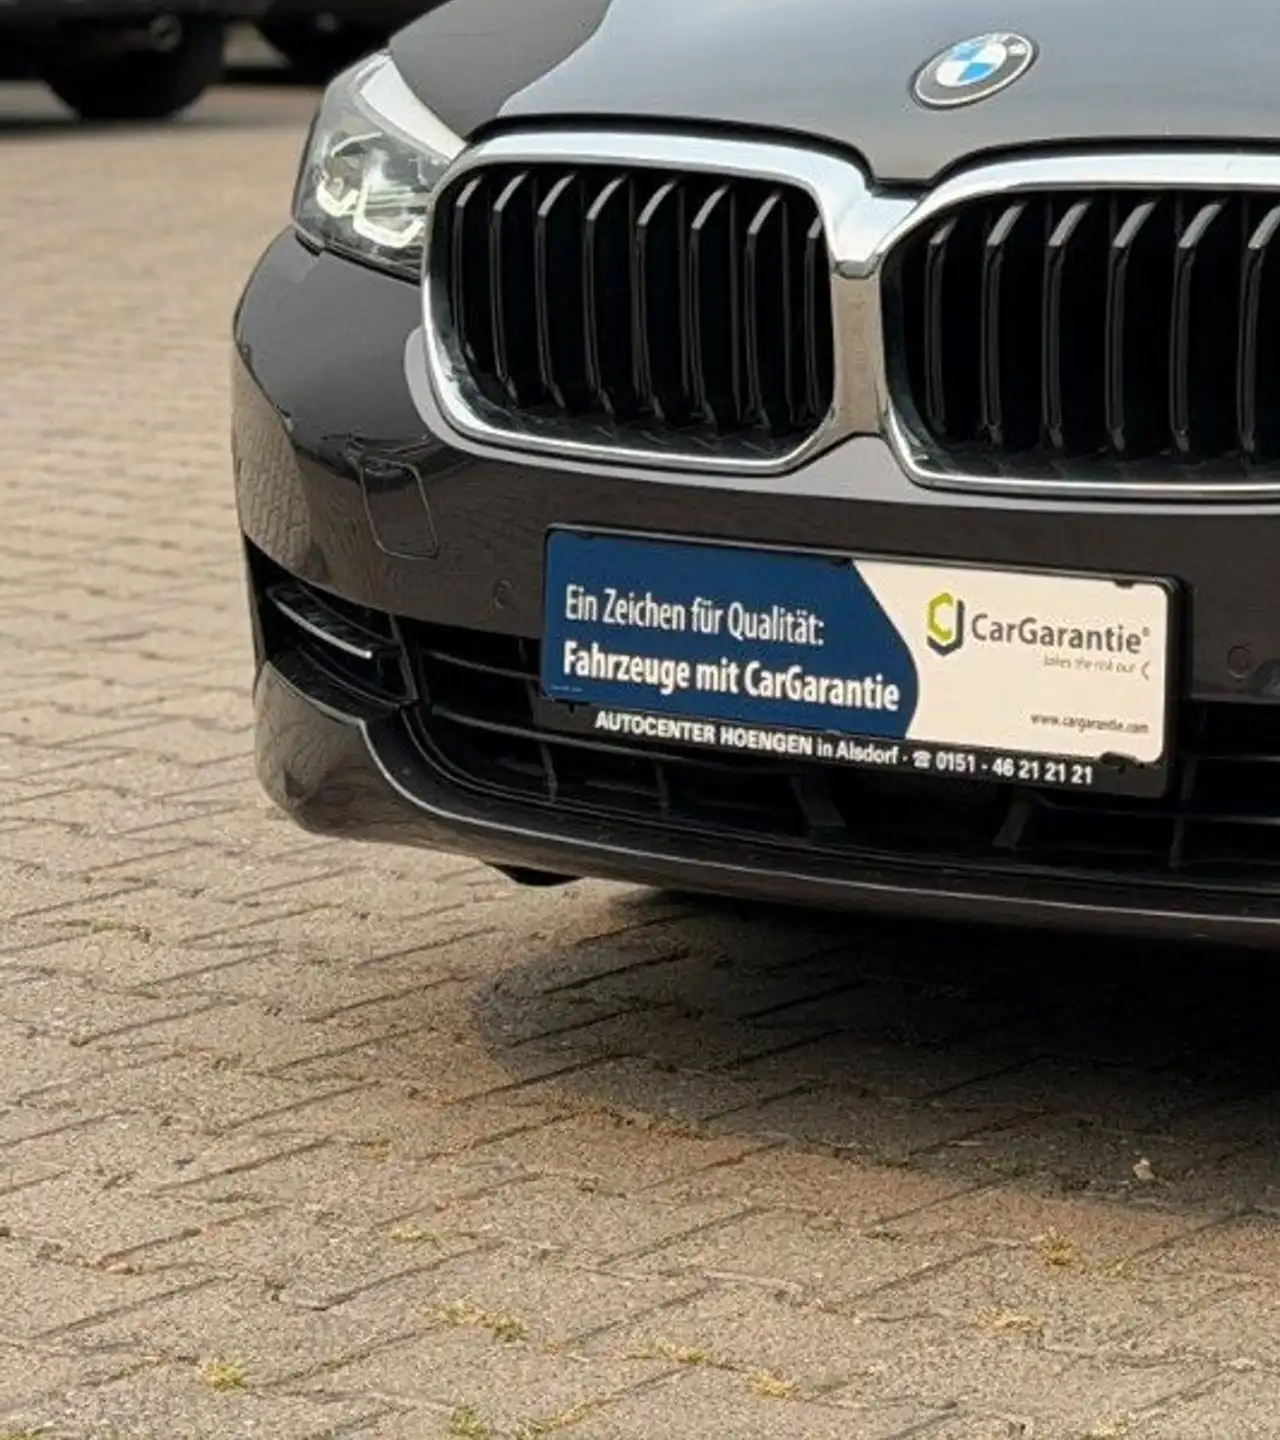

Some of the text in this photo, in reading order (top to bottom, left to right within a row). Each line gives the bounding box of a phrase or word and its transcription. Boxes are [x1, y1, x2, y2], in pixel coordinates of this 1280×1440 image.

[564, 583, 826, 646] Ein Zeichen für Qualität:
[563, 639, 901, 712] Fahrzeuge mit CarGarantie
[595, 710, 716, 744] AUTOCENTER
[720, 725, 814, 756] HOENGEN
[816, 737, 834, 757] in
[835, 738, 901, 765] Alsdorf
[935, 751, 975, 773] 0151
[992, 758, 1016, 777] 46
[1019, 760, 1039, 780] 21
[1044, 763, 1066, 782] 21
[1071, 765, 1094, 785] 21
